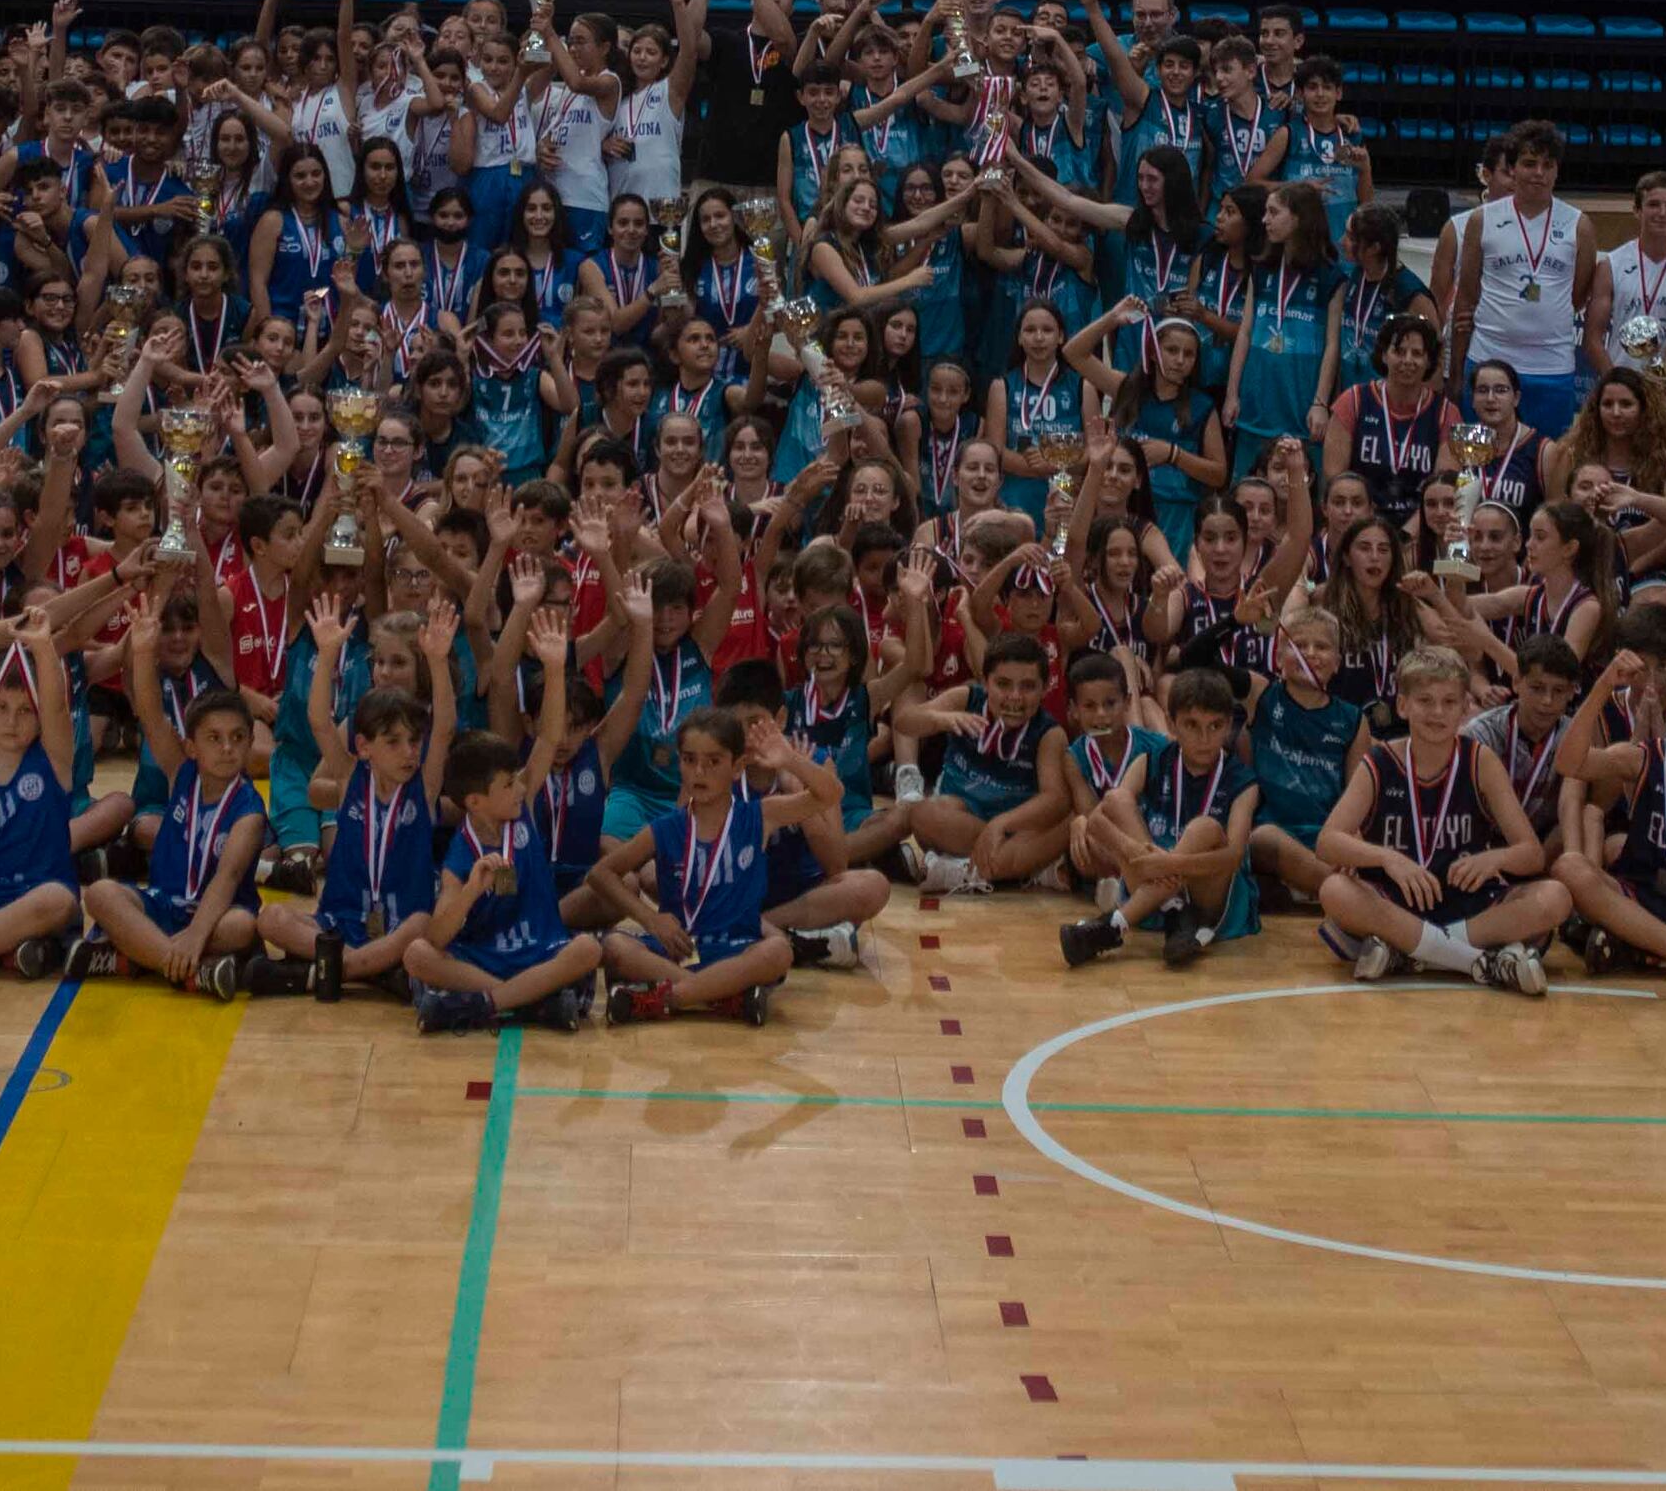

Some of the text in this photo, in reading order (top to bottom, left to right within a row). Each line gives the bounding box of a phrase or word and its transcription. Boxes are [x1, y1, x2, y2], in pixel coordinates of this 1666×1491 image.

[1236, 128, 1265, 153] 39
[1493, 251, 1565, 273] SALARES
[1144, 265, 1188, 285] camar
[1267, 307, 1315, 323] caamar
[500, 385, 512, 411] 7
[1029, 395, 1056, 420] 20
[1360, 435, 1432, 472] EL OYO
[1345, 649, 1365, 669] EL
[1383, 814, 1408, 851] EL
